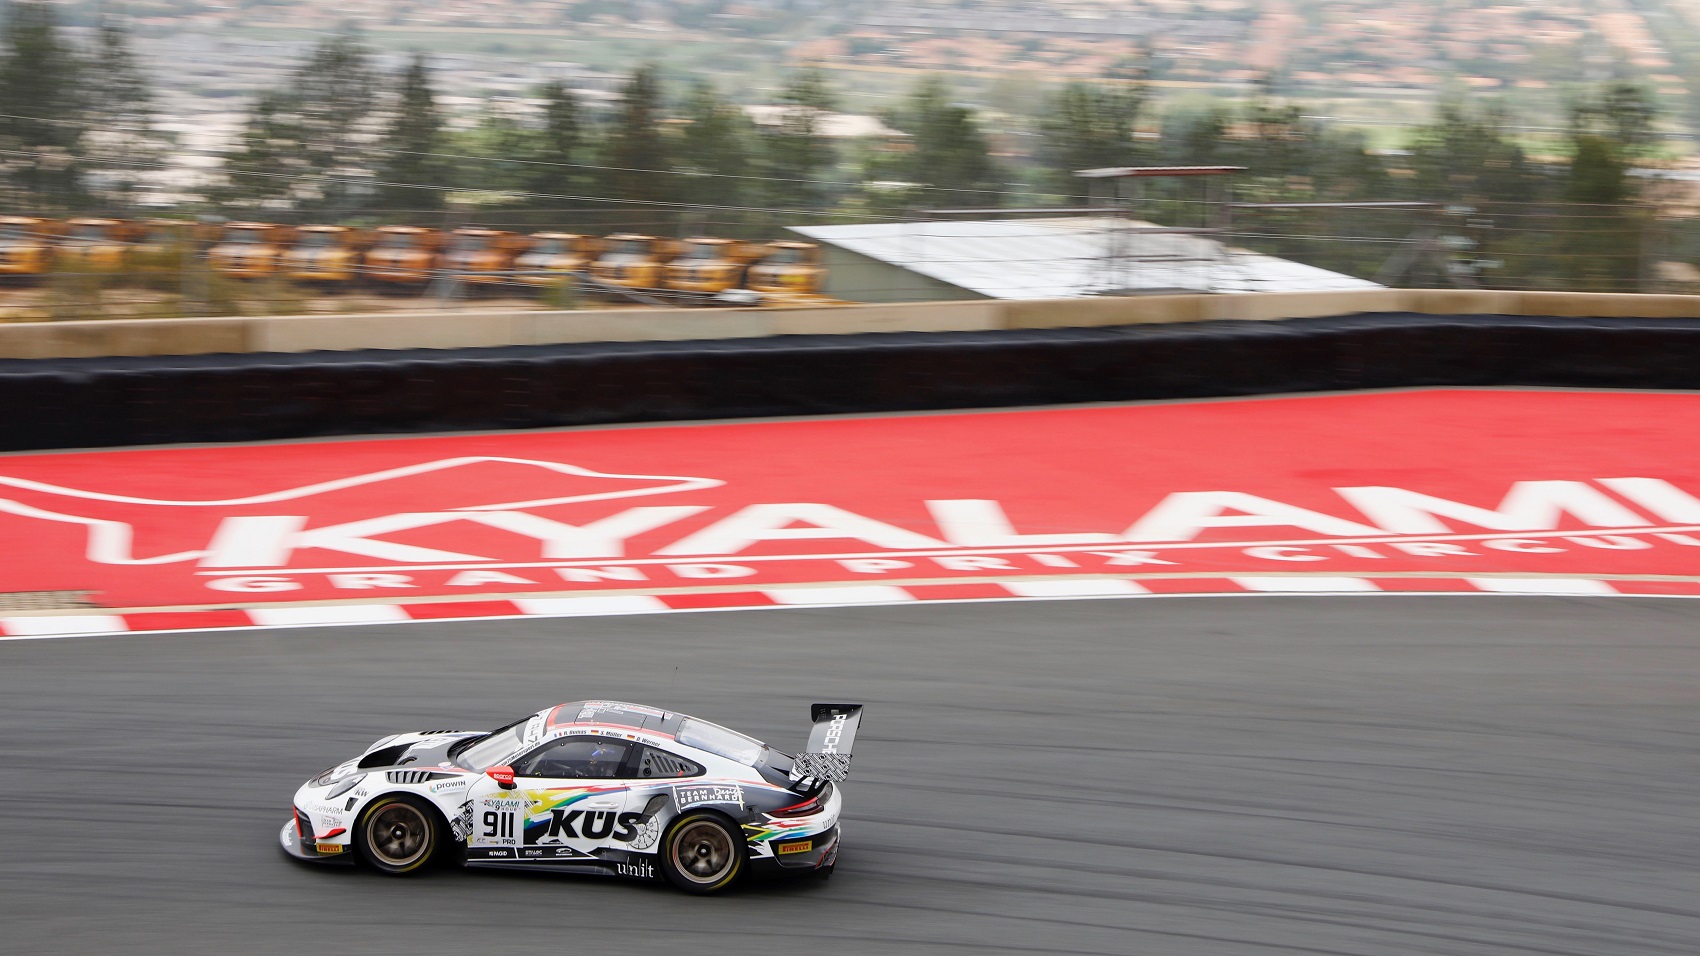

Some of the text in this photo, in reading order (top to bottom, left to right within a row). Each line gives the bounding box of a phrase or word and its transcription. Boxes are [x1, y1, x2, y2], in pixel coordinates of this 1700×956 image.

[197, 476, 1700, 567] KYALAMI
[204, 563, 758, 593] GRAND
[835, 551, 1181, 574] PRIX
[680, 789, 708, 798] TEAM
[680, 794, 738, 804] BERNHARD
[482, 811, 515, 838] 911
[548, 808, 640, 842] KÜS
